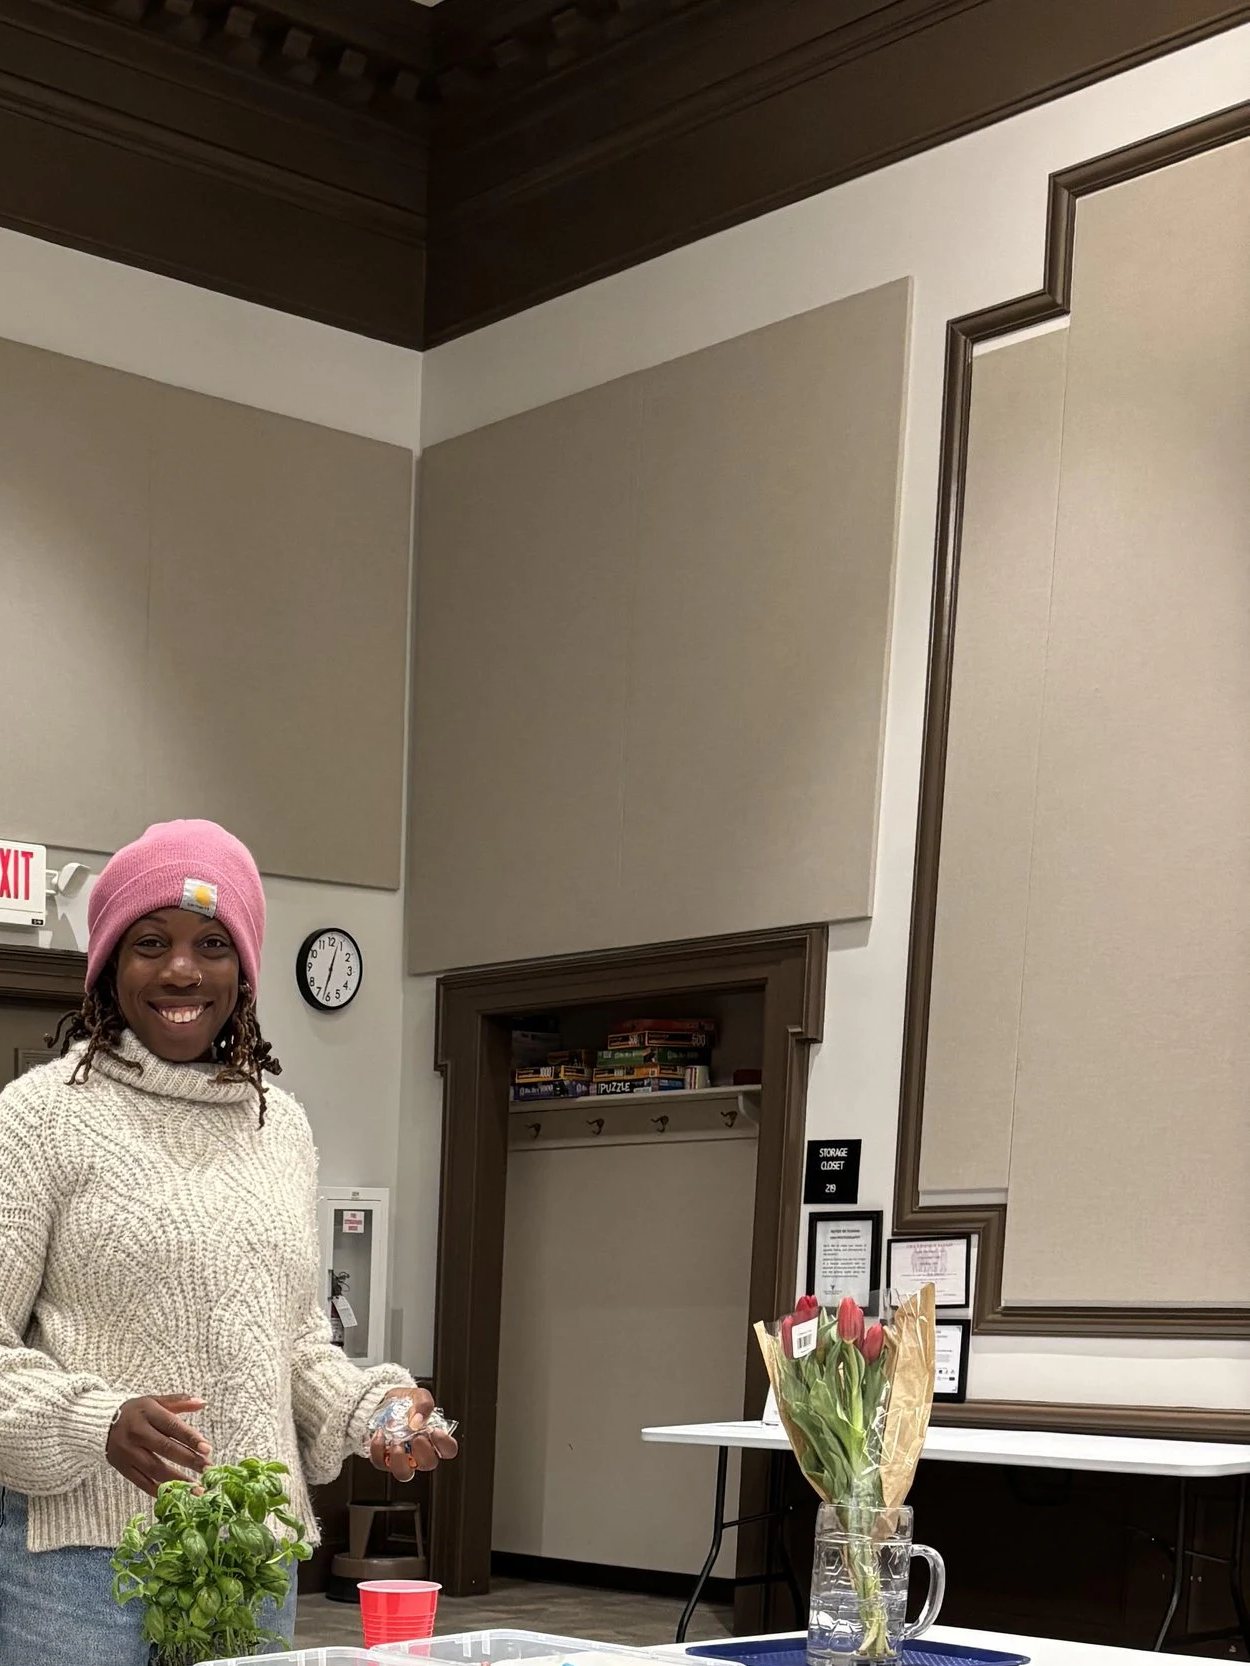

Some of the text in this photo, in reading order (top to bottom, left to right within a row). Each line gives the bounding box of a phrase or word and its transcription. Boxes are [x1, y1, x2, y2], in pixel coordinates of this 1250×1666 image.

[319, 939, 325, 950] 11
[328, 937, 336, 947] 12
[310, 949, 318, 959] 10
[345, 953, 351, 962] 2
[307, 962, 313, 972] 9
[347, 966, 353, 976] 3
[309, 977, 315, 987] 8
[343, 980, 348, 990] 4
[316, 986, 322, 996] 7
[335, 989, 341, 999] 5
[325, 992, 331, 1002] 6
[600, 1081, 630, 1094] PUZZLE
[819, 1147, 848, 1158] STORAGE
[820, 1160, 845, 1171] CLOSET
